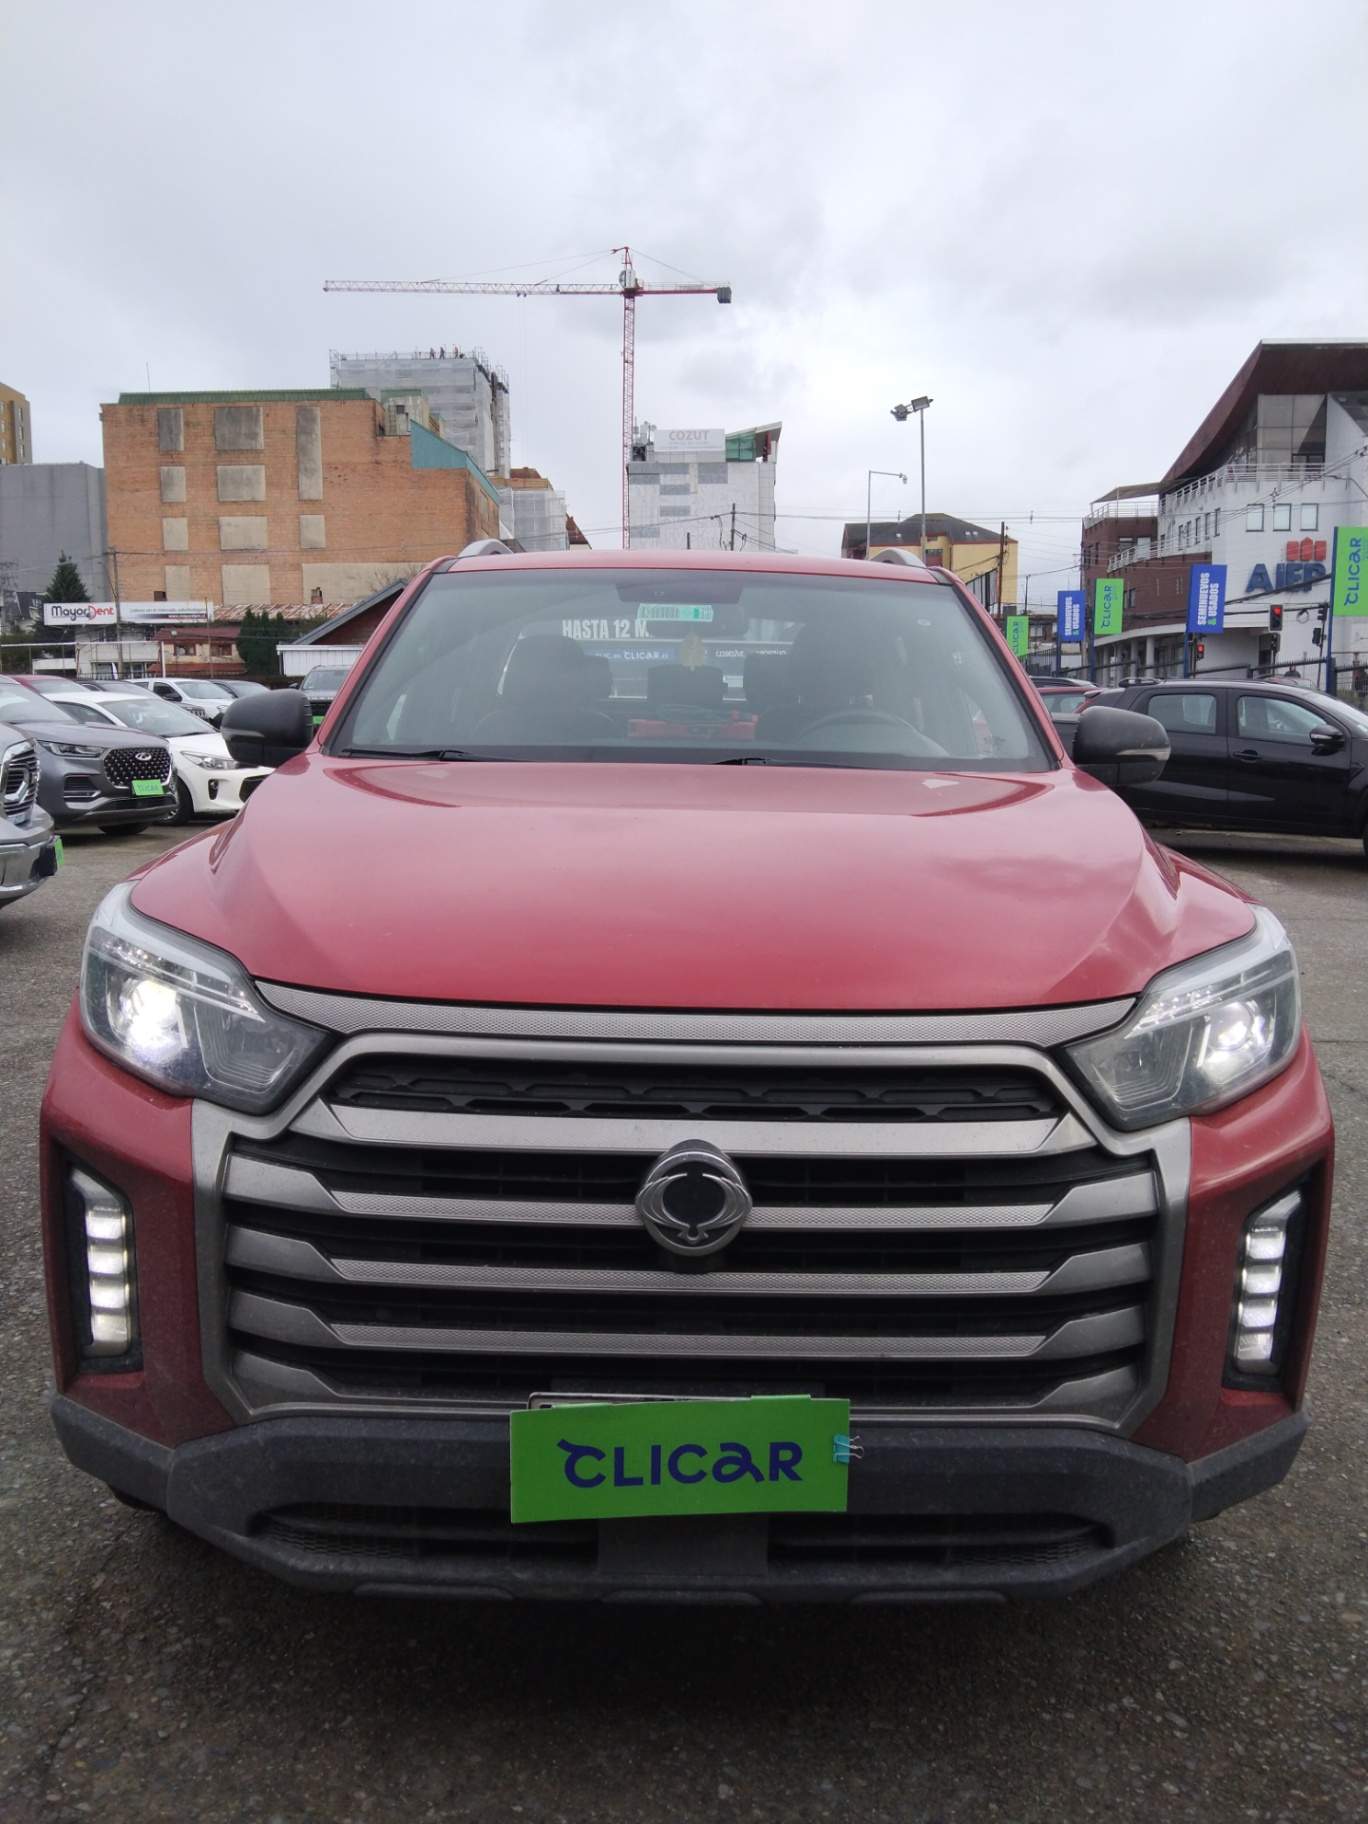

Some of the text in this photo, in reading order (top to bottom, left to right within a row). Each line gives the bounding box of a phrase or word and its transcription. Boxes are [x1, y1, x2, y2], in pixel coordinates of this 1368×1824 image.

[668, 430, 710, 441] COZUT
[1245, 562, 1327, 594] AIEP
[1197, 572, 1210, 625] SEMINUEVOS
[1207, 583, 1219, 617] USADOS
[562, 619, 609, 640] HASTA
[614, 619, 631, 639] 12
